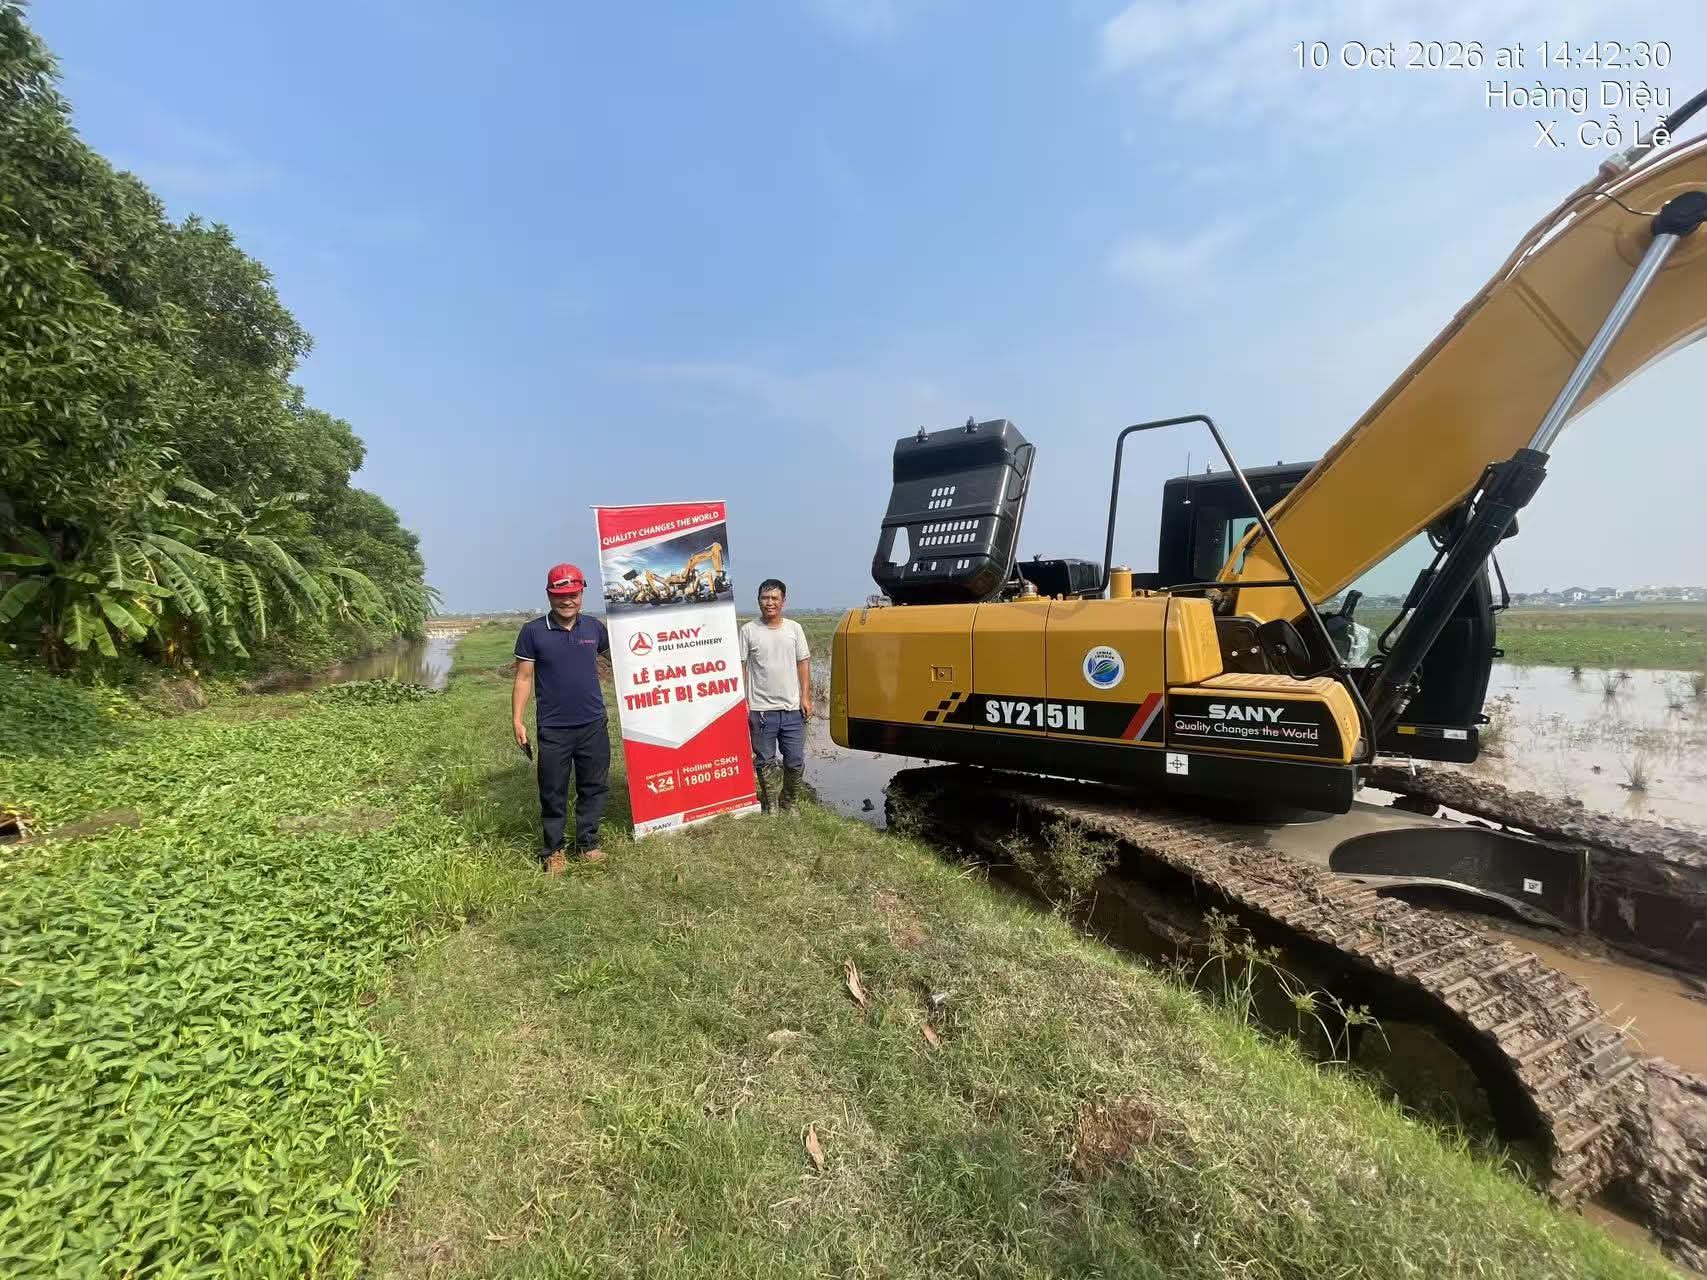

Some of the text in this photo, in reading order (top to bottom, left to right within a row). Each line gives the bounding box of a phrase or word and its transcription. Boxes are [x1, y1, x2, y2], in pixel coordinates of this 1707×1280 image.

[602, 511, 719, 546] QUALITY CHANGES THE WORLD
[656, 627, 702, 643] SANY
[658, 637, 723, 652] FULI MACHINERY
[632, 660, 727, 686] LỄ BÀN GIAO
[623, 677, 739, 711] THIẾT BỊ SANY
[985, 700, 1085, 731] SY215H
[1208, 704, 1285, 723] SANY
[1175, 720, 1319, 740] Quality Changes the World
[682, 755, 739, 774] Hotline CSKH
[658, 776, 674, 788] 24
[683, 772, 712, 787] 1800
[713, 765, 740, 780] 6831
